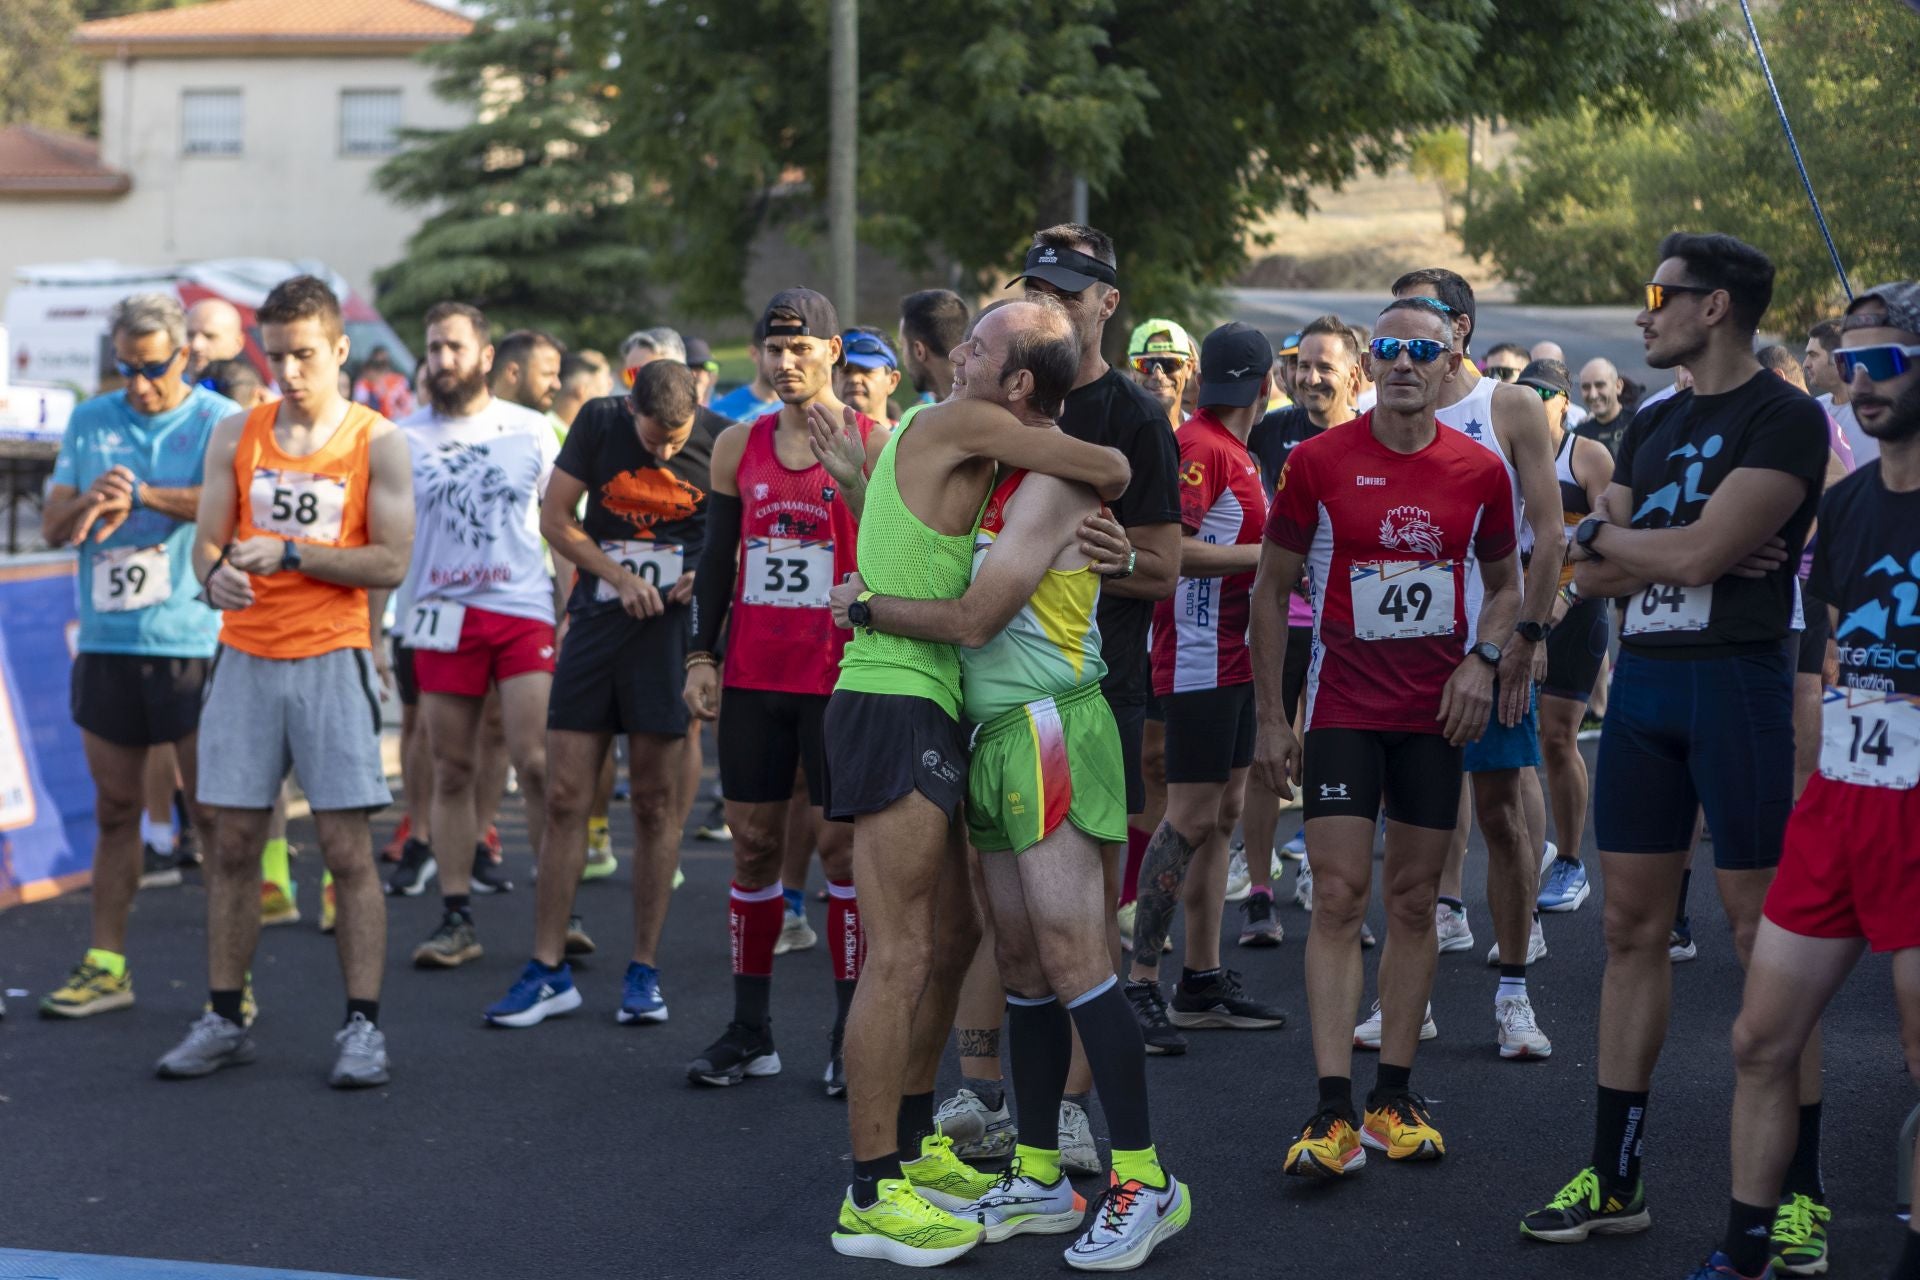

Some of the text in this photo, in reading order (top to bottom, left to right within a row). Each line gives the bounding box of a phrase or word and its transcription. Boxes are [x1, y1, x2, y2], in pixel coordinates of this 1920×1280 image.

[271, 487, 319, 525] 58
[756, 500, 829, 520] CLUB MARATÓN
[109, 565, 148, 598] 59
[764, 557, 810, 593] 33
[1186, 592, 1195, 616] CLUB
[1378, 582, 1433, 623] 49
[1641, 583, 1686, 616] 64
[414, 608, 440, 636] 71
[1849, 715, 1895, 766] 14
